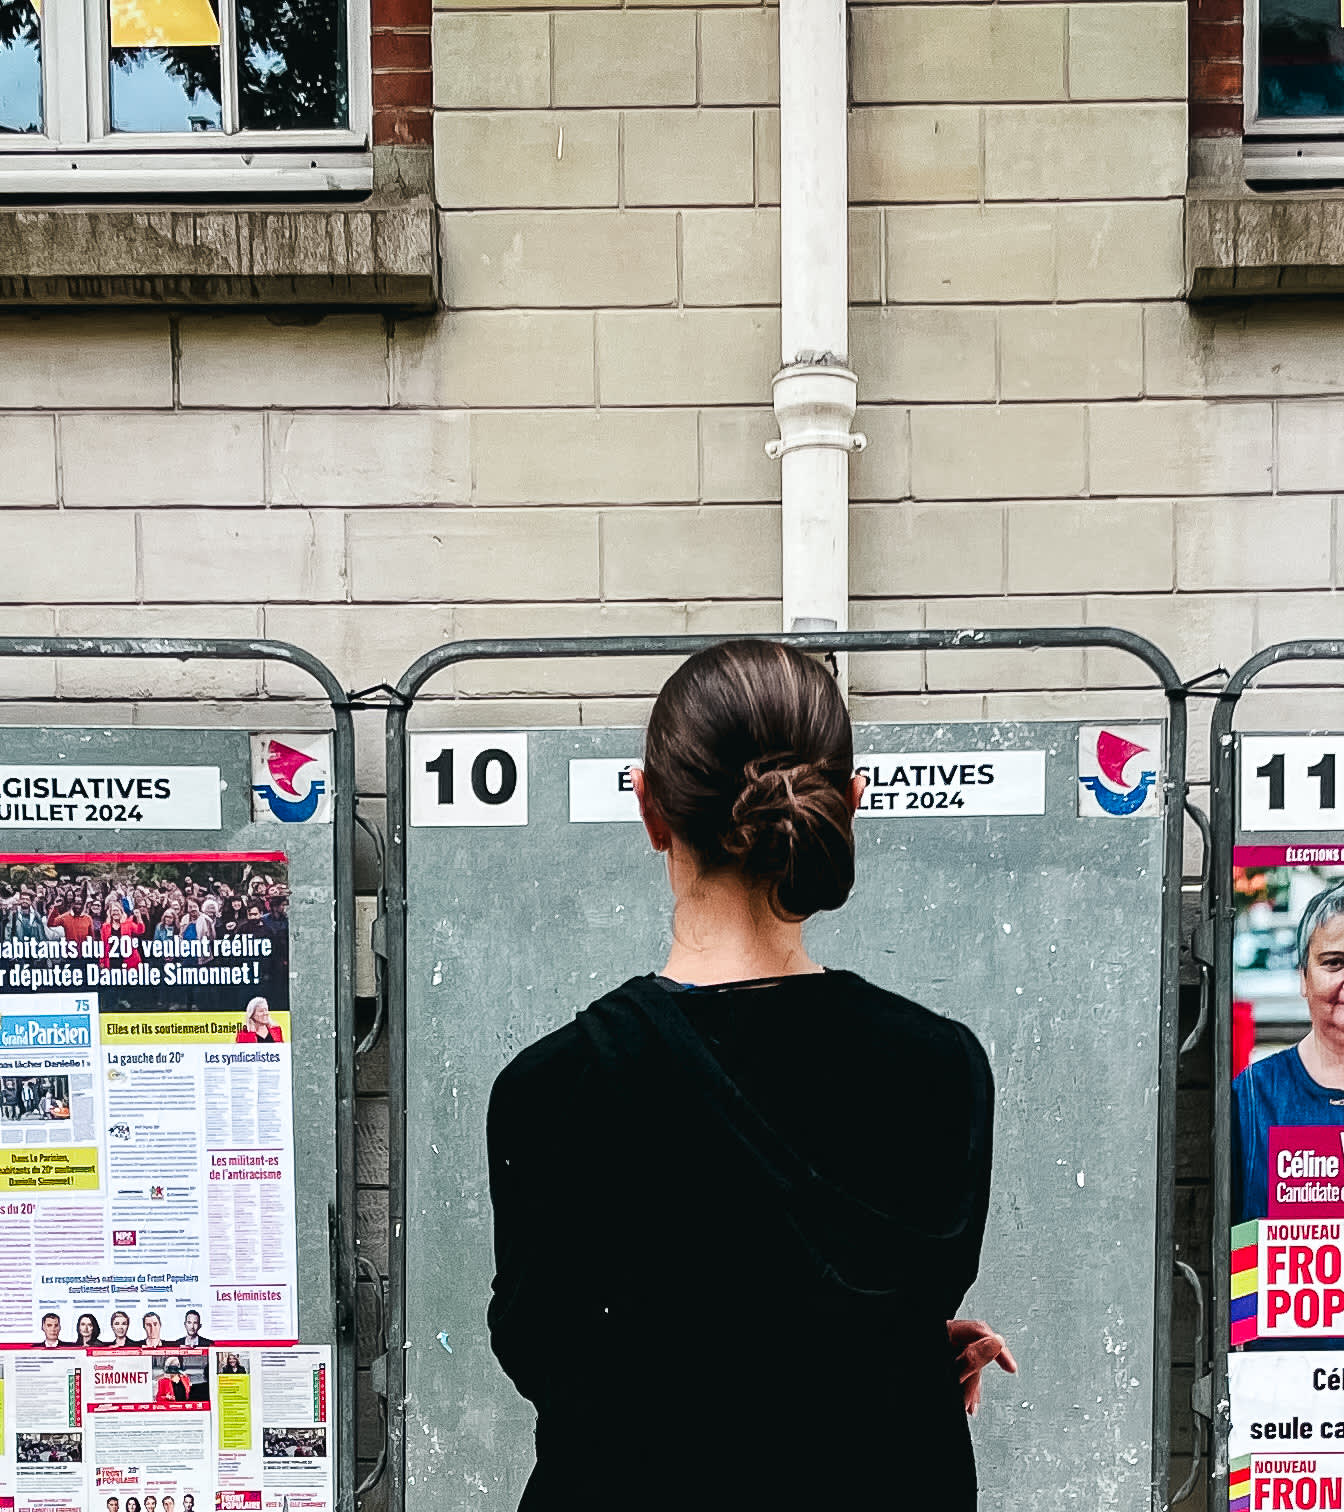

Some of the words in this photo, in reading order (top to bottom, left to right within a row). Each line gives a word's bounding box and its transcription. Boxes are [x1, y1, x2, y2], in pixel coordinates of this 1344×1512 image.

[425, 748, 518, 806] 10
[1256, 753, 1337, 810] 11
[906, 791, 965, 810] 2024
[85, 804, 143, 822] 2024
[1286, 847, 1340, 862] ÉLECTIONS
[81, 936, 105, 958] du
[142, 935, 210, 957] veulent
[212, 933, 272, 956] réélire
[9, 964, 83, 990] députée
[86, 963, 161, 987] Danielle
[164, 962, 249, 985] Simonnet
[75, 1000, 90, 1012] 75
[28, 1020, 89, 1045] Parisien
[106, 1023, 129, 1035] Elles
[154, 1022, 209, 1034] soutiennent
[107, 1052, 118, 1065] La
[120, 1053, 154, 1066] gauche
[204, 1051, 220, 1063] Les
[221, 1051, 281, 1065] syndicalistes
[211, 1155, 227, 1166] Les
[1276, 1149, 1340, 1179] Céline
[209, 1169, 221, 1180] de
[1276, 1181, 1340, 1203] Candidate
[7, 1203, 19, 1214] du
[1266, 1224, 1341, 1241] NOUVEAU
[233, 1289, 282, 1301] féministes
[94, 1372, 149, 1385] SIMONNET
[1249, 1416, 1313, 1440] seule
[1254, 1459, 1317, 1474] NOUVEAU
